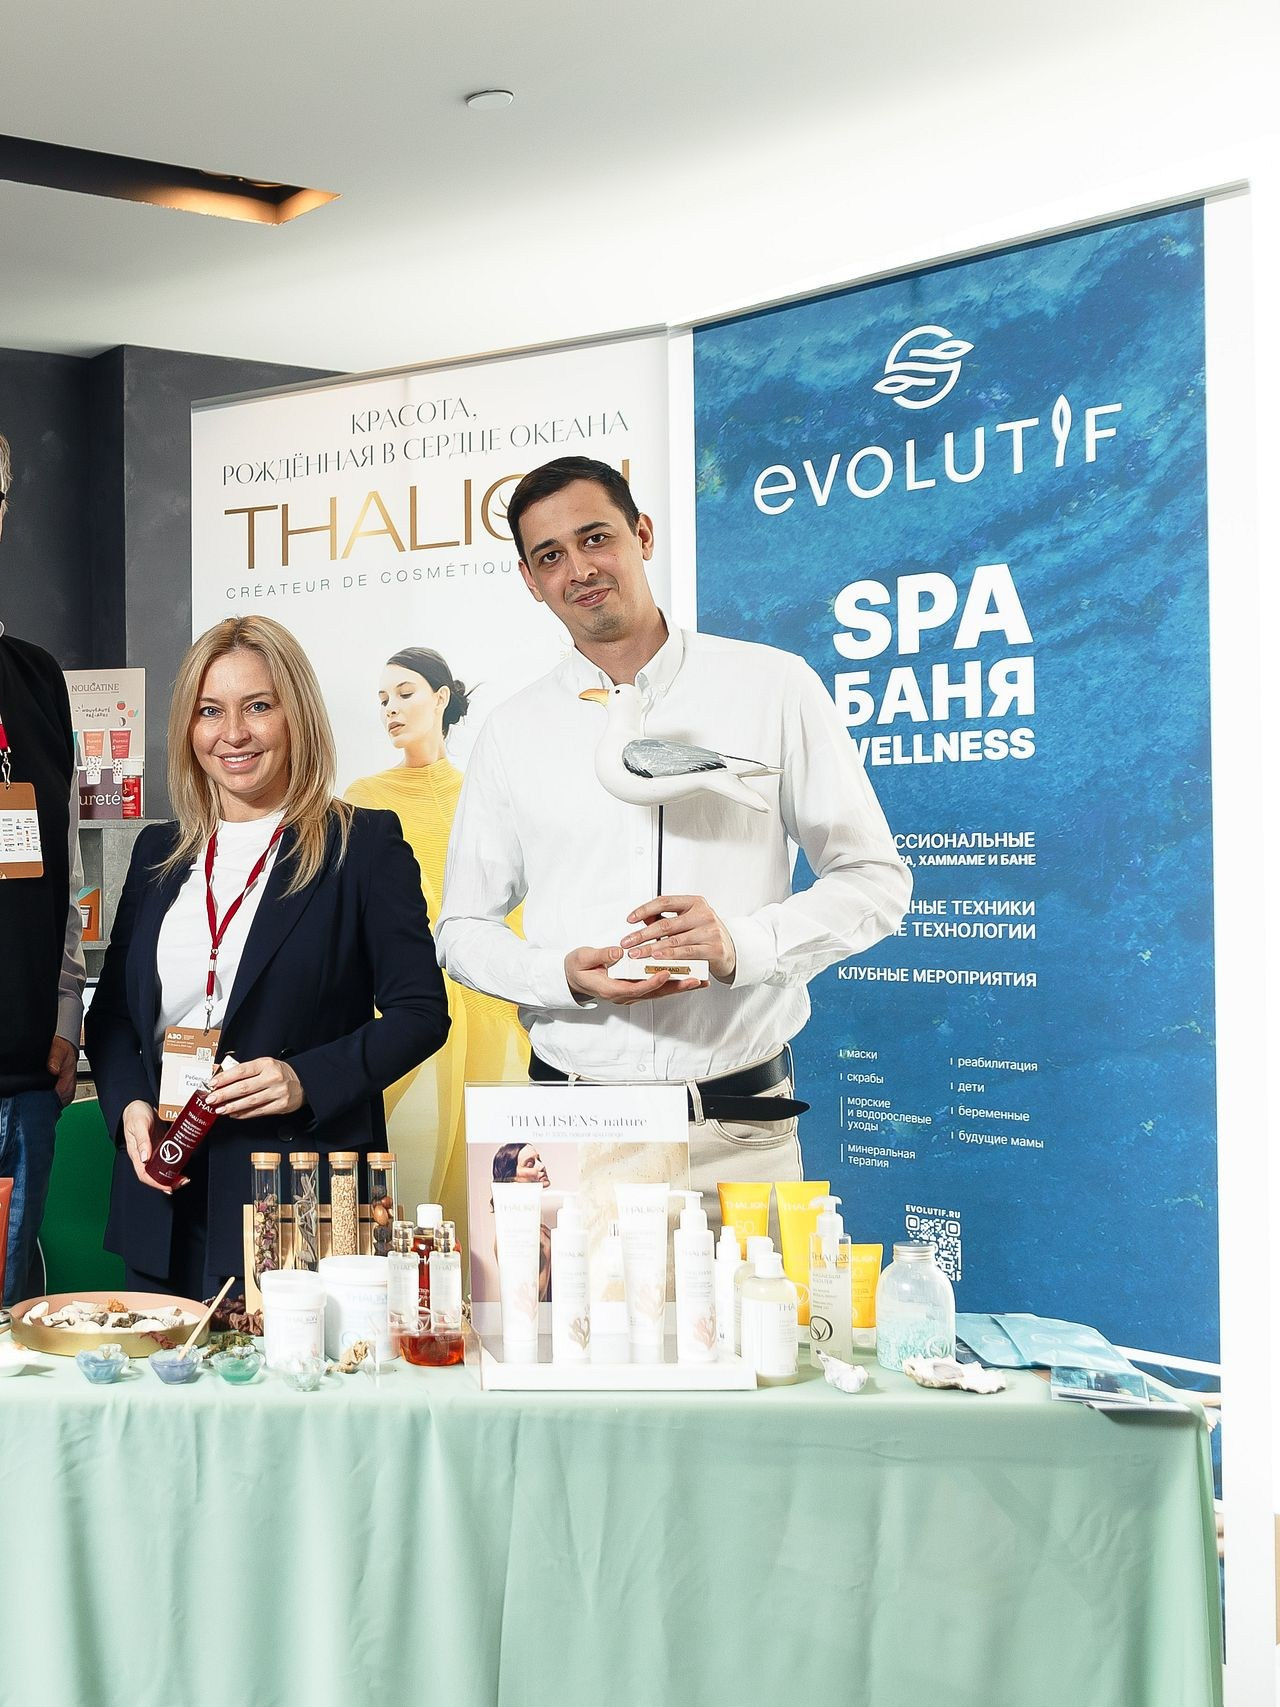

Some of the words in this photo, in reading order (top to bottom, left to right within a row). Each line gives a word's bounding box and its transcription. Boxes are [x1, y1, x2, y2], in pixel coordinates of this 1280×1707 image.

[351, 397, 477, 435] КРАСОТА,
[223, 444, 374, 486] РОЖДЁННАЯ
[382, 442, 396, 465] В
[403, 428, 502, 461] СЕРДЦЕ
[510, 410, 629, 448] ОКЕАНА
[226, 583, 330, 599] CRÉATEUR
[343, 574, 367, 588] DE
[381, 560, 513, 584] COSMÉTIQU
[833, 563, 1034, 660] SPA
[71, 682, 120, 692] NOUGATINE
[834, 656, 1036, 728] БАНЯ
[79, 791, 121, 806] ureté
[893, 832, 1036, 849] ССИОНАЛЬНЫЕ
[918, 854, 985, 866] ХАММАМЕ
[988, 855, 998, 865] И
[1001, 854, 1036, 865] БАНЕ
[910, 899, 946, 915] НЫЕ
[951, 900, 1035, 916] ТЕХНИКИ
[912, 921, 1036, 940] ТЕХНОЛОГИИ
[838, 966, 909, 982] КЛУБНЫЕ
[913, 969, 1037, 987] МЕРОПРИЯТИЯ
[847, 1049, 878, 1060] маски
[957, 1057, 1038, 1073] реабилитация
[847, 1073, 884, 1084] скрабы
[957, 1082, 985, 1093] дети
[847, 1097, 891, 1109] морские
[507, 1114, 599, 1127] THALISENS
[604, 1116, 648, 1127] nature
[847, 1109, 854, 1117] и
[856, 1110, 932, 1125] водорослевые
[958, 1105, 1030, 1121] беременные
[847, 1121, 879, 1132] уходы
[958, 1130, 1008, 1145] будущие
[1010, 1136, 1044, 1149] мамы
[847, 1144, 916, 1160] минеральная
[848, 1155, 889, 1169] терапия
[905, 1204, 961, 1219] EVOLUTIF.RU
